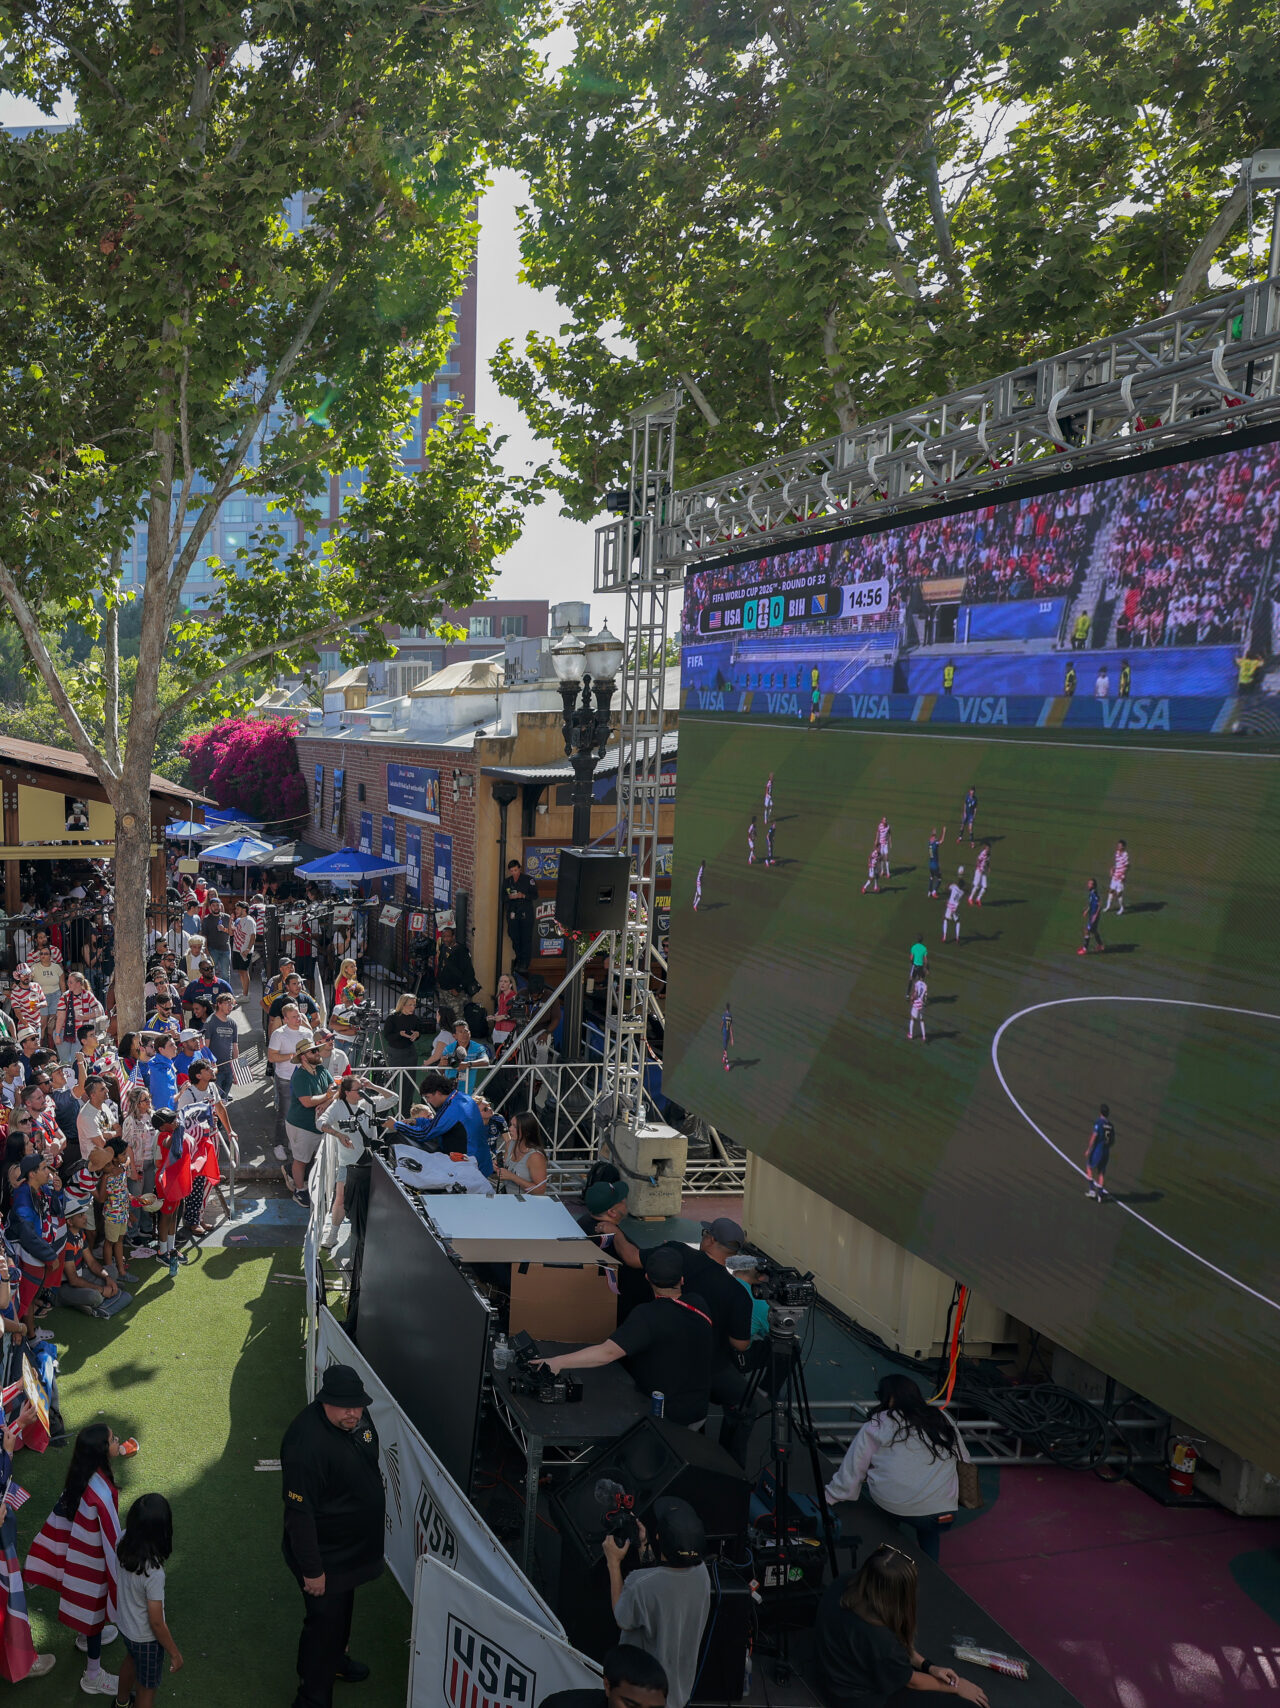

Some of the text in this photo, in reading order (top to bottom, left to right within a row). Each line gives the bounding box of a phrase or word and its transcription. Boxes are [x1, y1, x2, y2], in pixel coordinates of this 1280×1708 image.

[712, 594, 725, 604] FIFA
[724, 590, 745, 603] WORLD
[746, 588, 759, 598] CUP
[782, 579, 807, 592] ROUND
[807, 576, 816, 586] OF
[817, 574, 826, 585] 32
[848, 587, 881, 610] 14:56
[723, 609, 741, 627] USA
[747, 606, 753, 623] 0
[773, 602, 780, 619] 0
[787, 597, 806, 618] BIH
[686, 655, 704, 668] FIFA
[698, 691, 725, 711] VISA
[765, 692, 798, 713] VISA
[848, 694, 889, 720] VISA
[954, 696, 1009, 725] VISA
[1096, 698, 1171, 731] VISA
[419, 1493, 455, 1560] USA
[453, 1626, 527, 1701] USA
